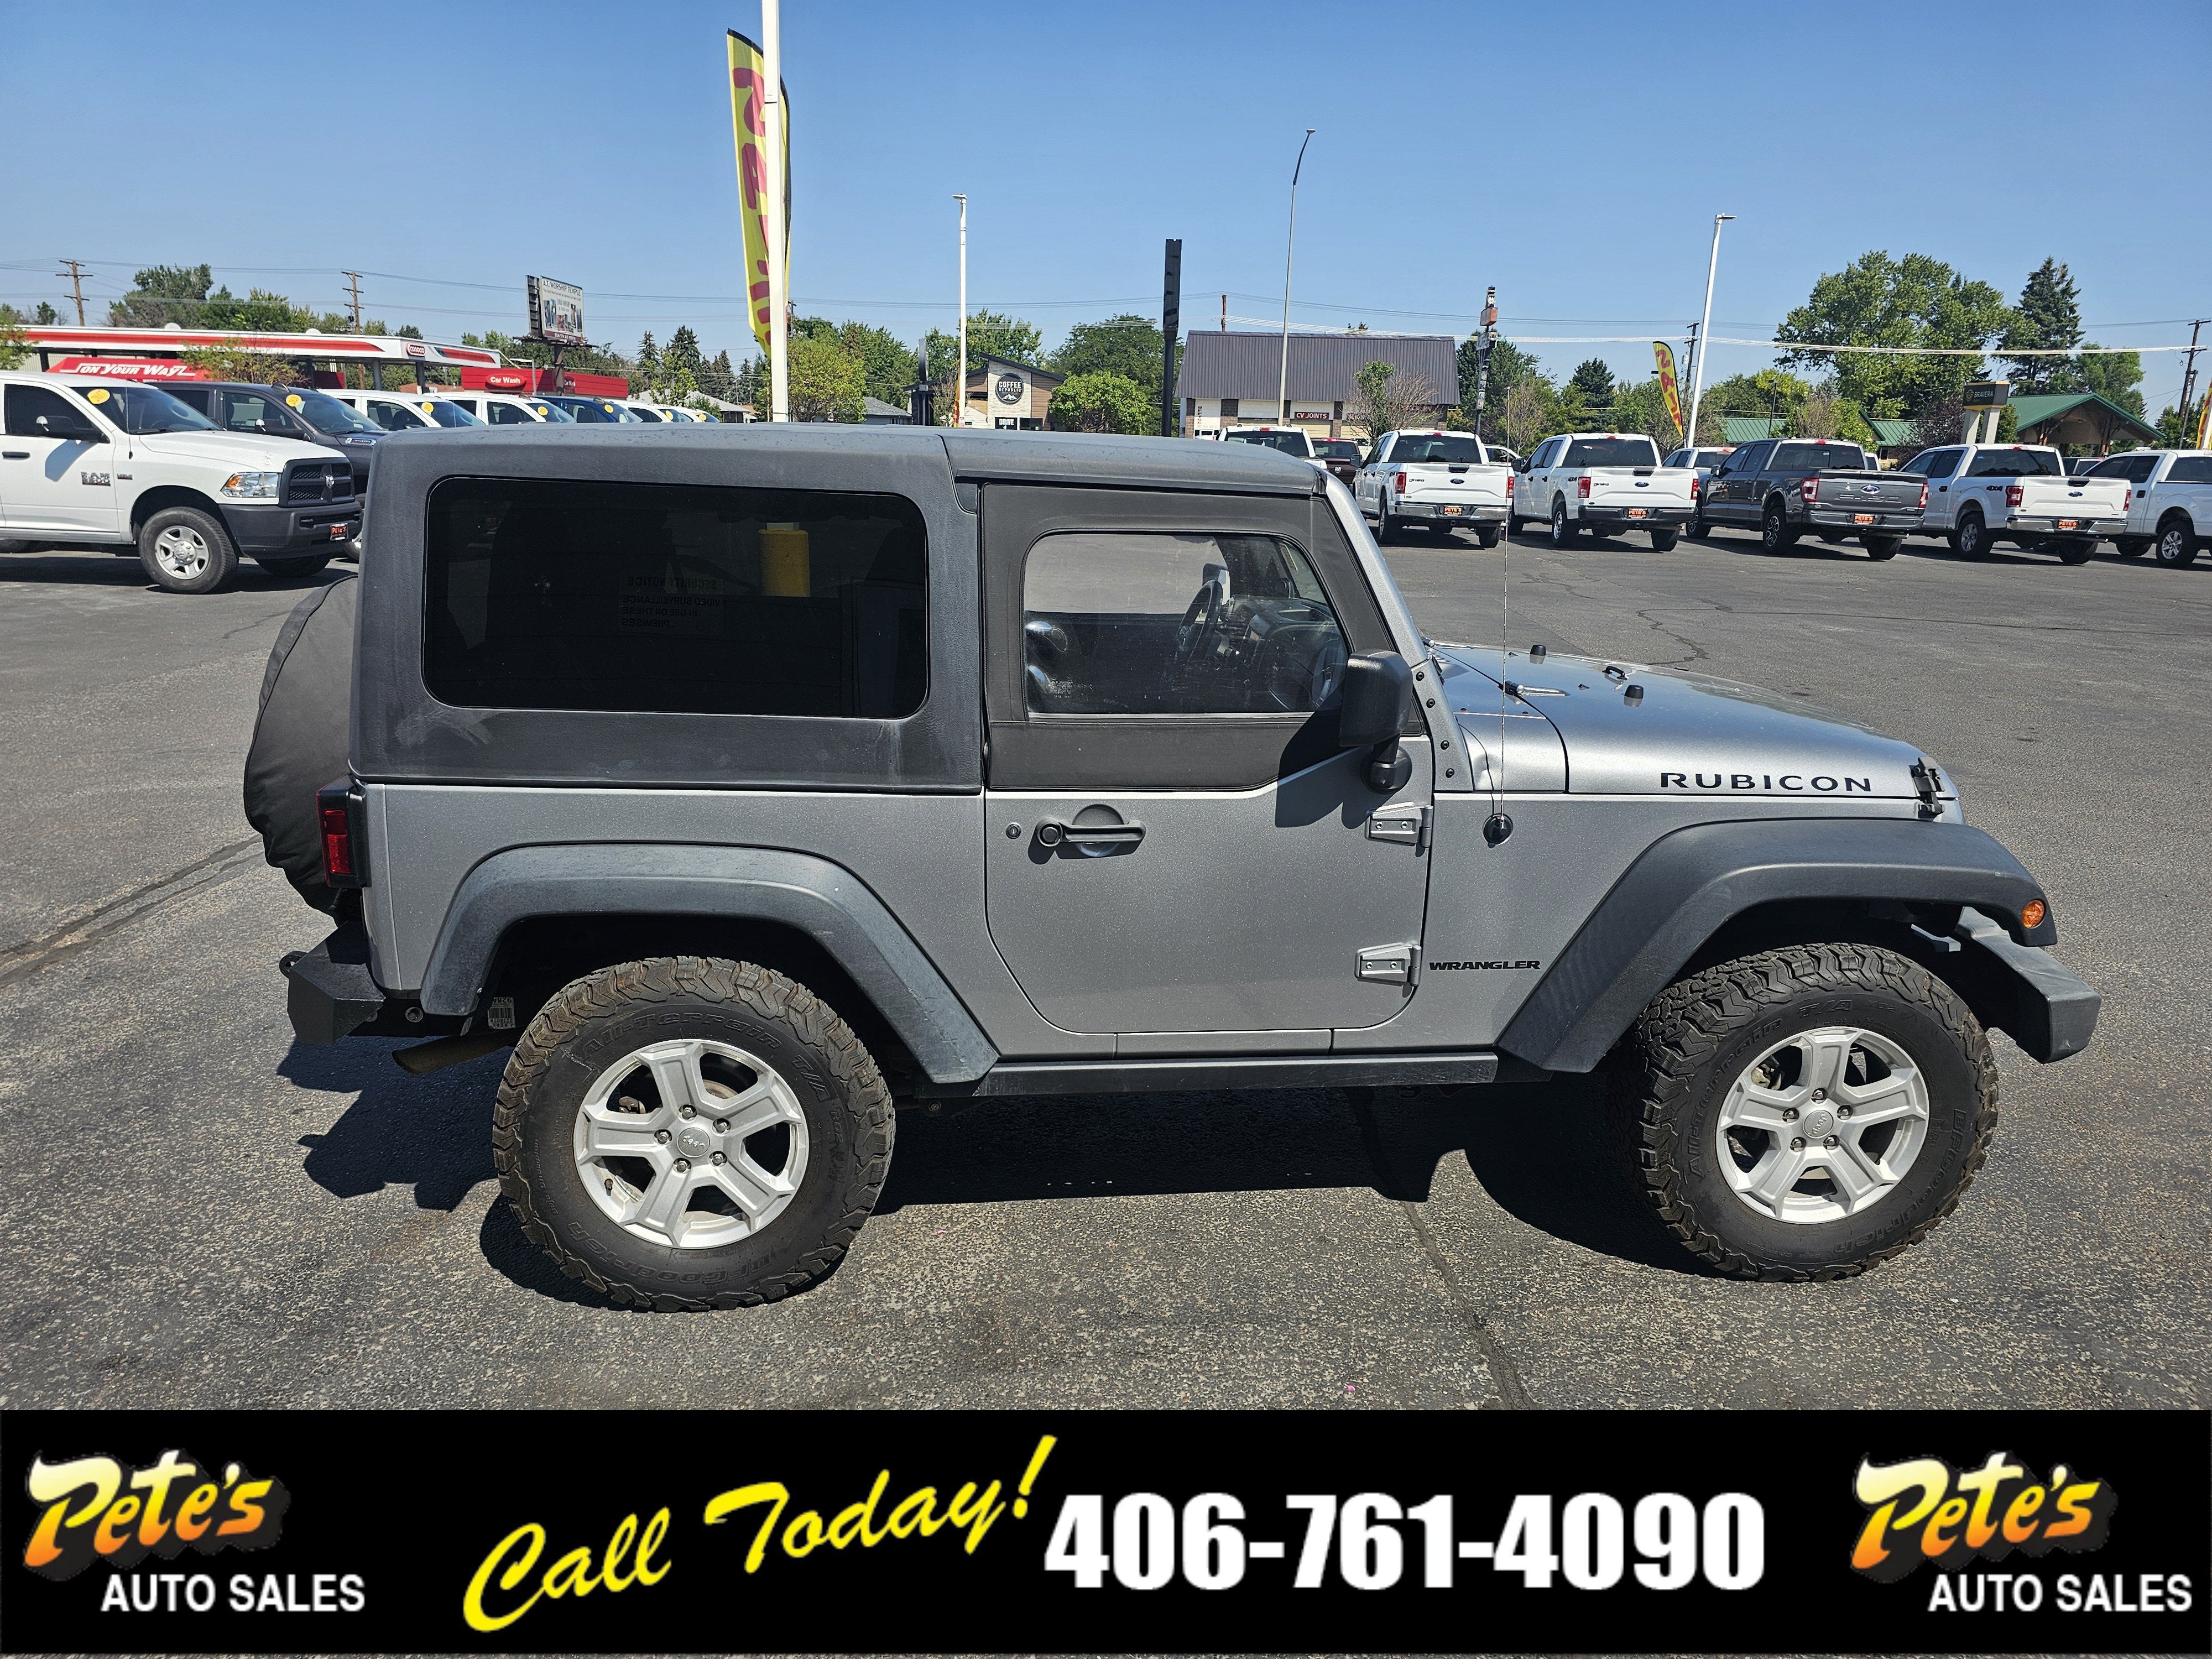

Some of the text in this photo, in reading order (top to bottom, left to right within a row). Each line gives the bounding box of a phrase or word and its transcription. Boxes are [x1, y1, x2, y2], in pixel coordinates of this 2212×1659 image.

[550, 281, 567, 292] WORSHIP
[568, 286, 581, 296] TEMPLE
[79, 366, 101, 374] ON
[100, 364, 140, 375] YOUR
[1661, 773, 1871, 792] RUBICON
[1428, 961, 1541, 971] WRANGLER
[1798, 999, 1852, 1019] T/A
[580, 1010, 782, 1057] All-Terrain
[1687, 1016, 1783, 1179] All-Terrain
[1812, 1113, 1827, 1135] Jeep
[1834, 1108, 1968, 1254] BFGoodrich
[566, 1220, 771, 1285] BFGoodrich
